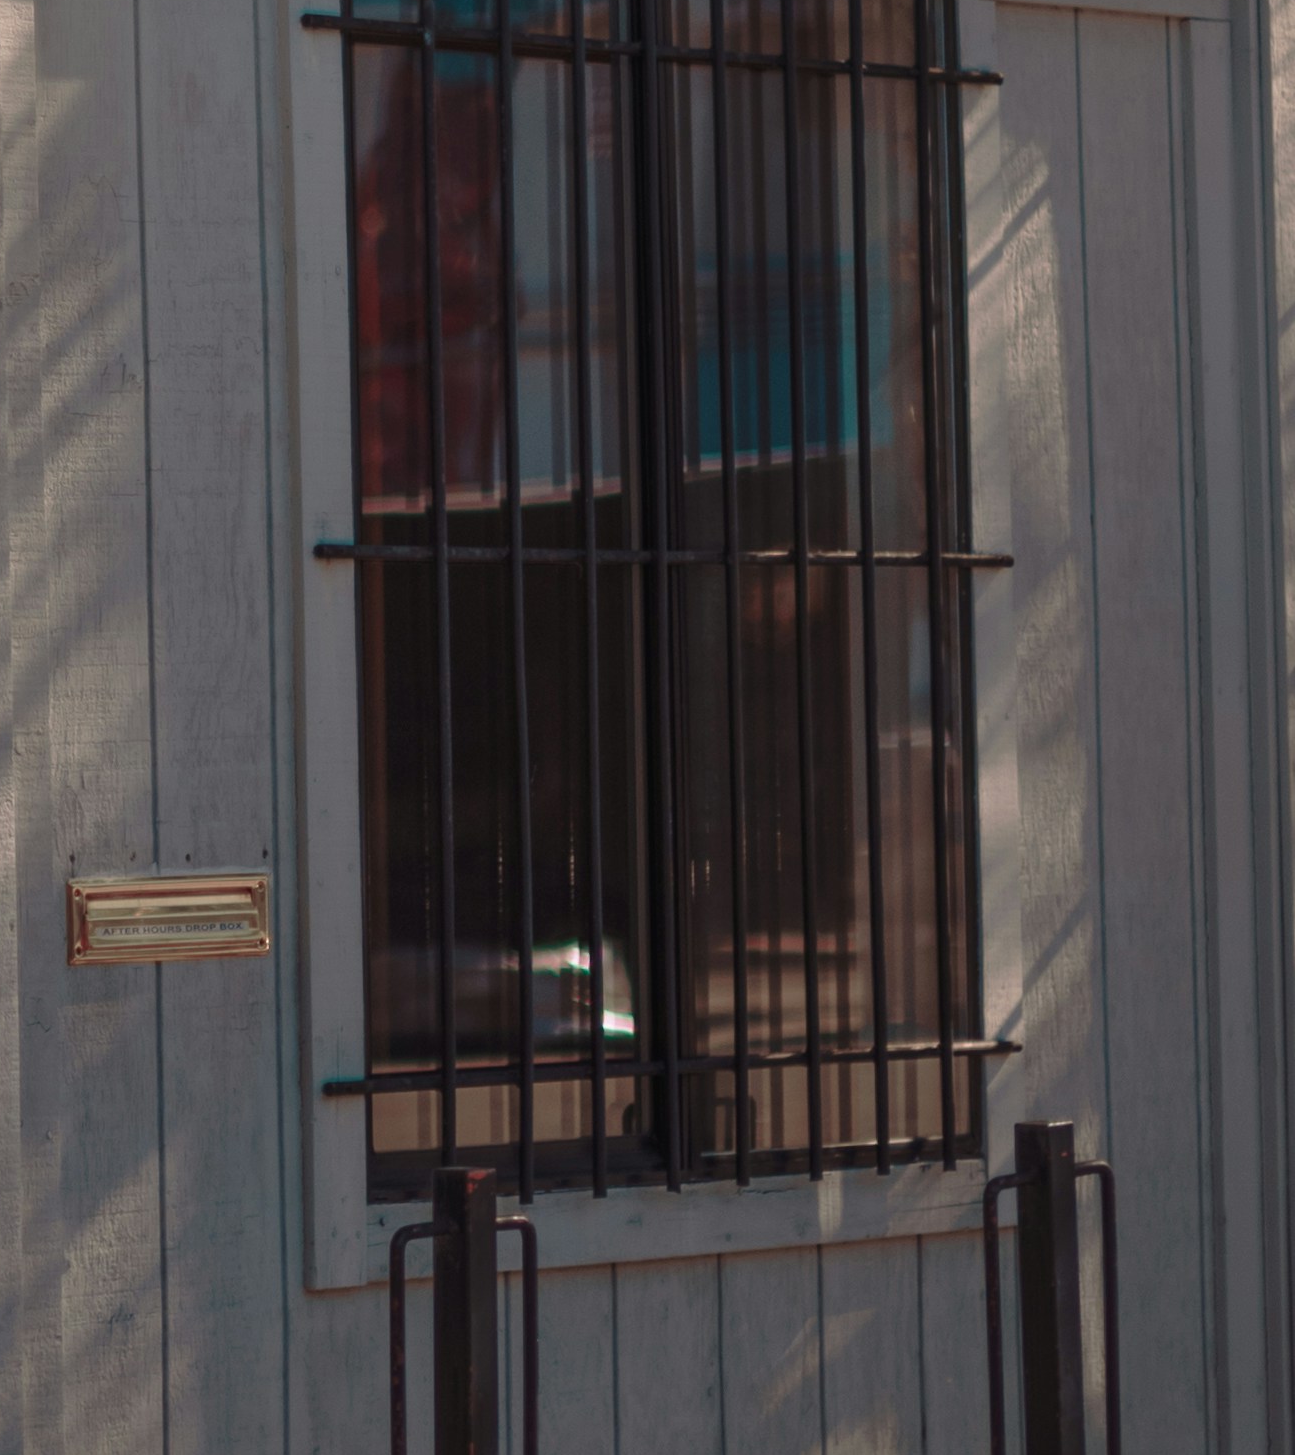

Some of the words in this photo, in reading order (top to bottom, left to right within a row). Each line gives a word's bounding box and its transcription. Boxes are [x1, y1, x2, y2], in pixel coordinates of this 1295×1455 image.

[101, 926, 140, 937] AFTER
[142, 924, 183, 935] HOURS
[184, 923, 217, 933] DROP
[218, 922, 244, 931] BOX
